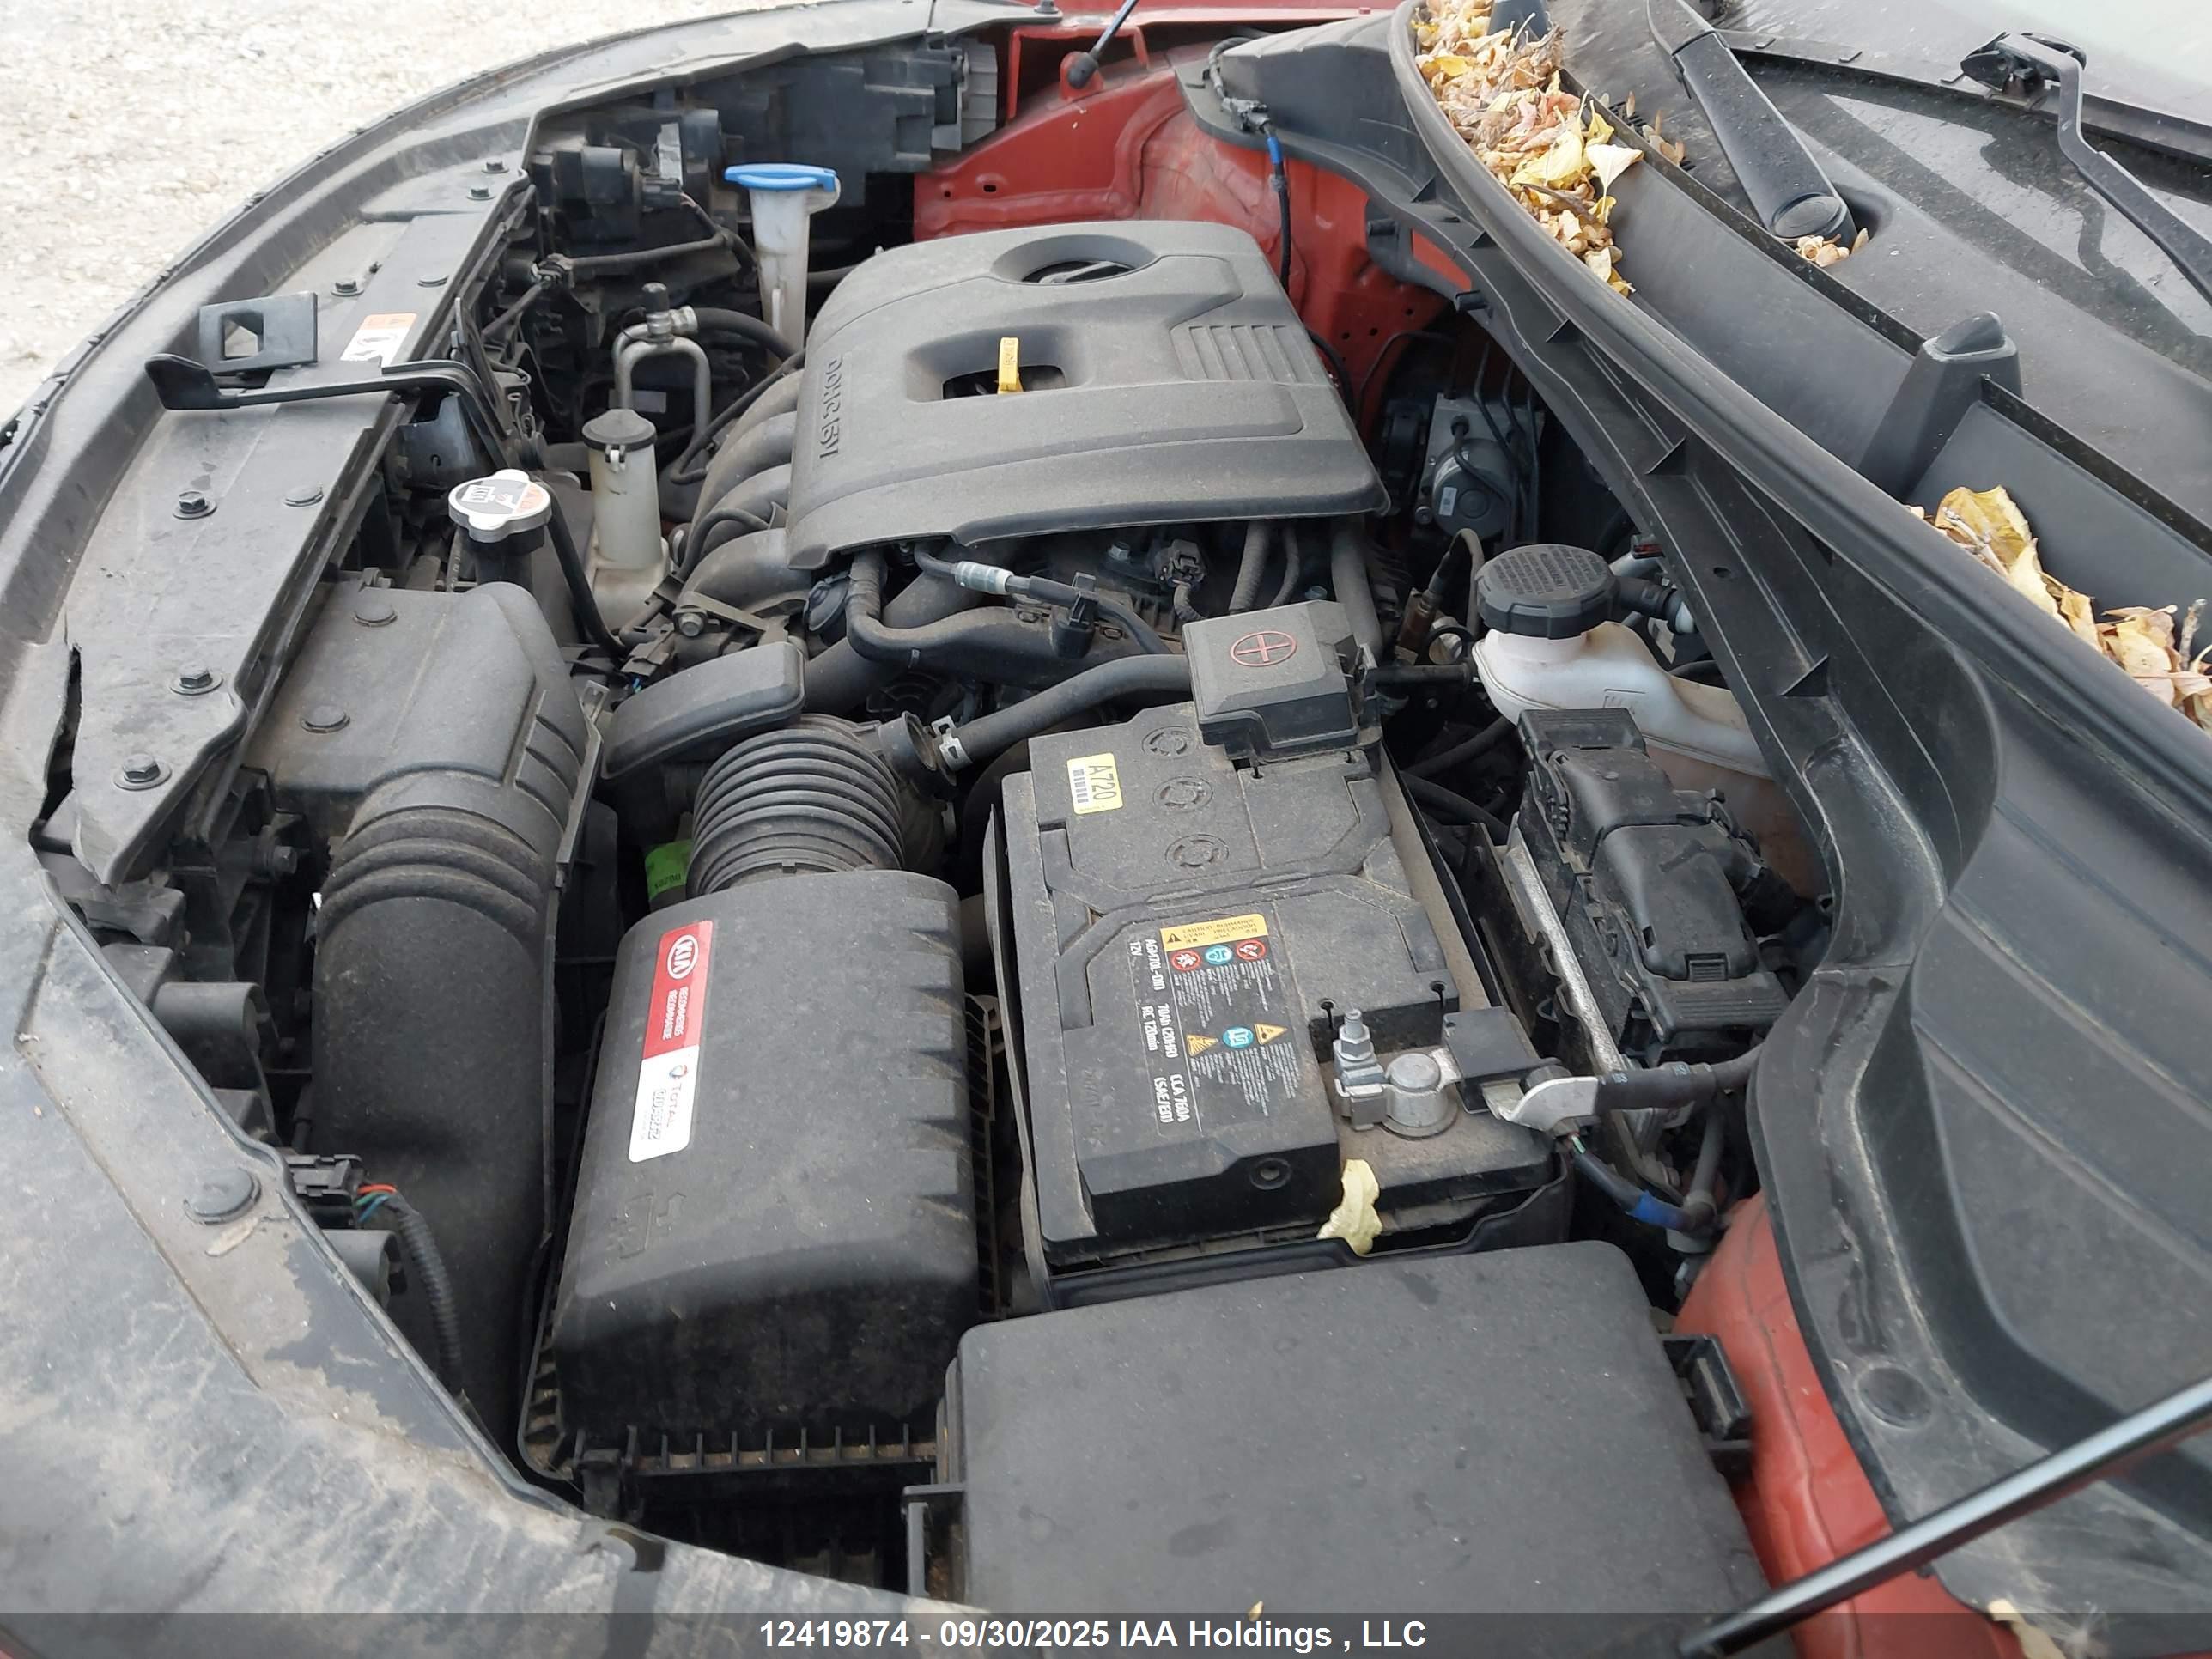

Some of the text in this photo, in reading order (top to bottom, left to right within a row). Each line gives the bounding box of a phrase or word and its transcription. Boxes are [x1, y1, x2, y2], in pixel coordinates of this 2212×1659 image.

[1088, 765, 1117, 800] A720
[672, 940, 694, 974] KIA
[1129, 941, 1143, 956] 12V
[1141, 1006, 1156, 1020] RC
[1157, 1003, 1172, 1026] 70Ah
[1161, 1027, 1179, 1058] (20HR)
[1170, 1073, 1186, 1096] CCA
[667, 1082, 682, 1127] TOTAL
[1174, 1096, 1191, 1122] 760A
